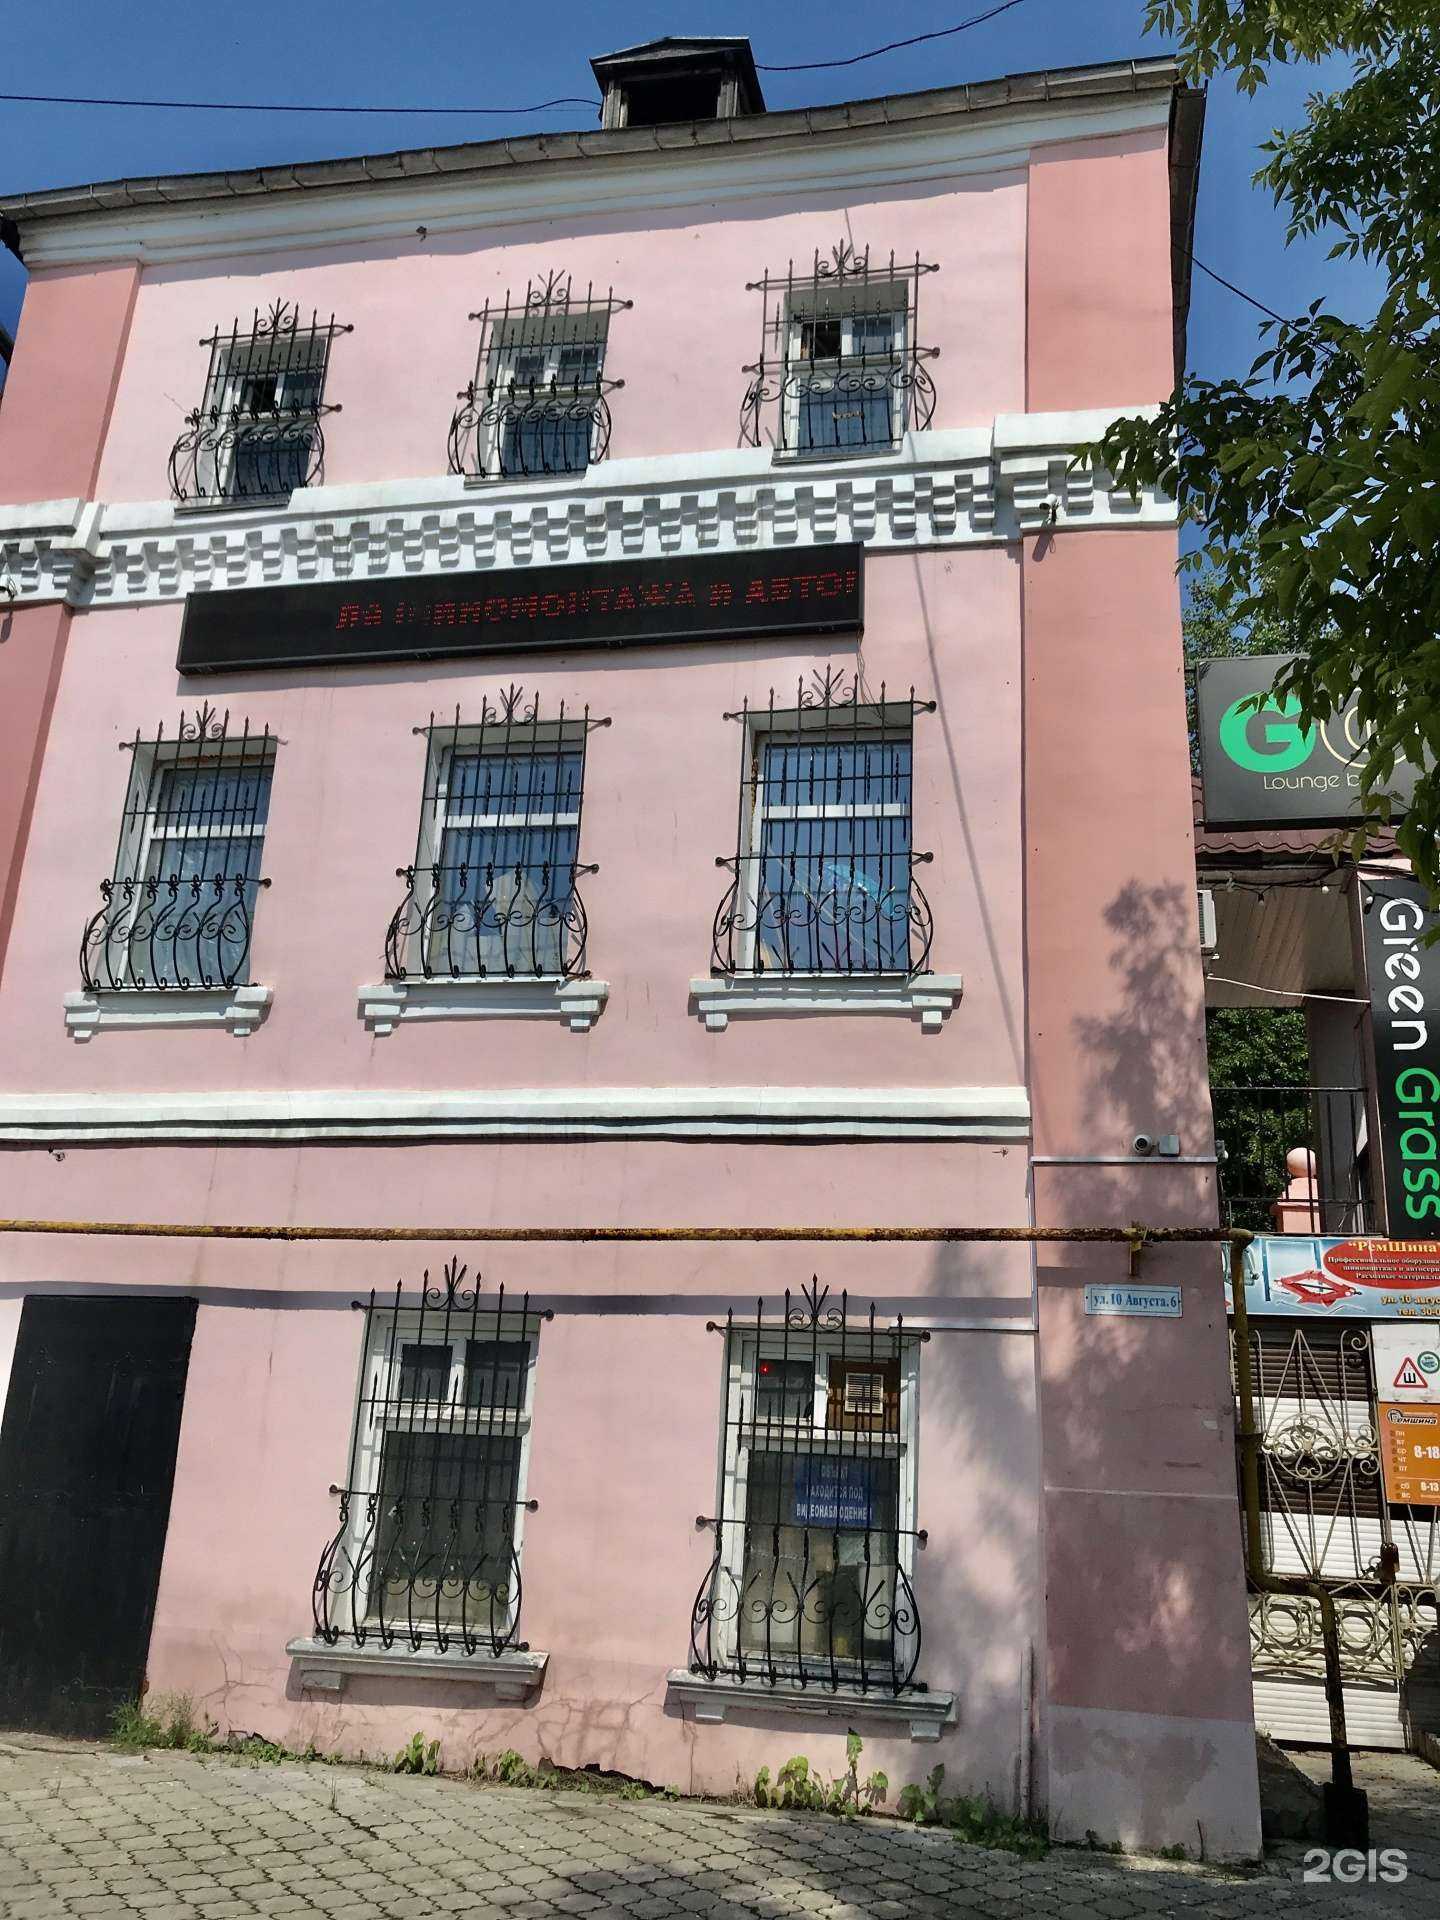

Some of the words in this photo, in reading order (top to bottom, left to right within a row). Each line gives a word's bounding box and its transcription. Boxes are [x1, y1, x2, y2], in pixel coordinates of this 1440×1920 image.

[1263, 773, 1340, 792] Lounge
[1346, 772, 1382, 788] br
[1379, 897, 1428, 1051] Green
[1395, 1067, 1440, 1220] Grass
[1093, 1294, 1109, 1307] ул.
[1111, 1293, 1122, 1306] 10
